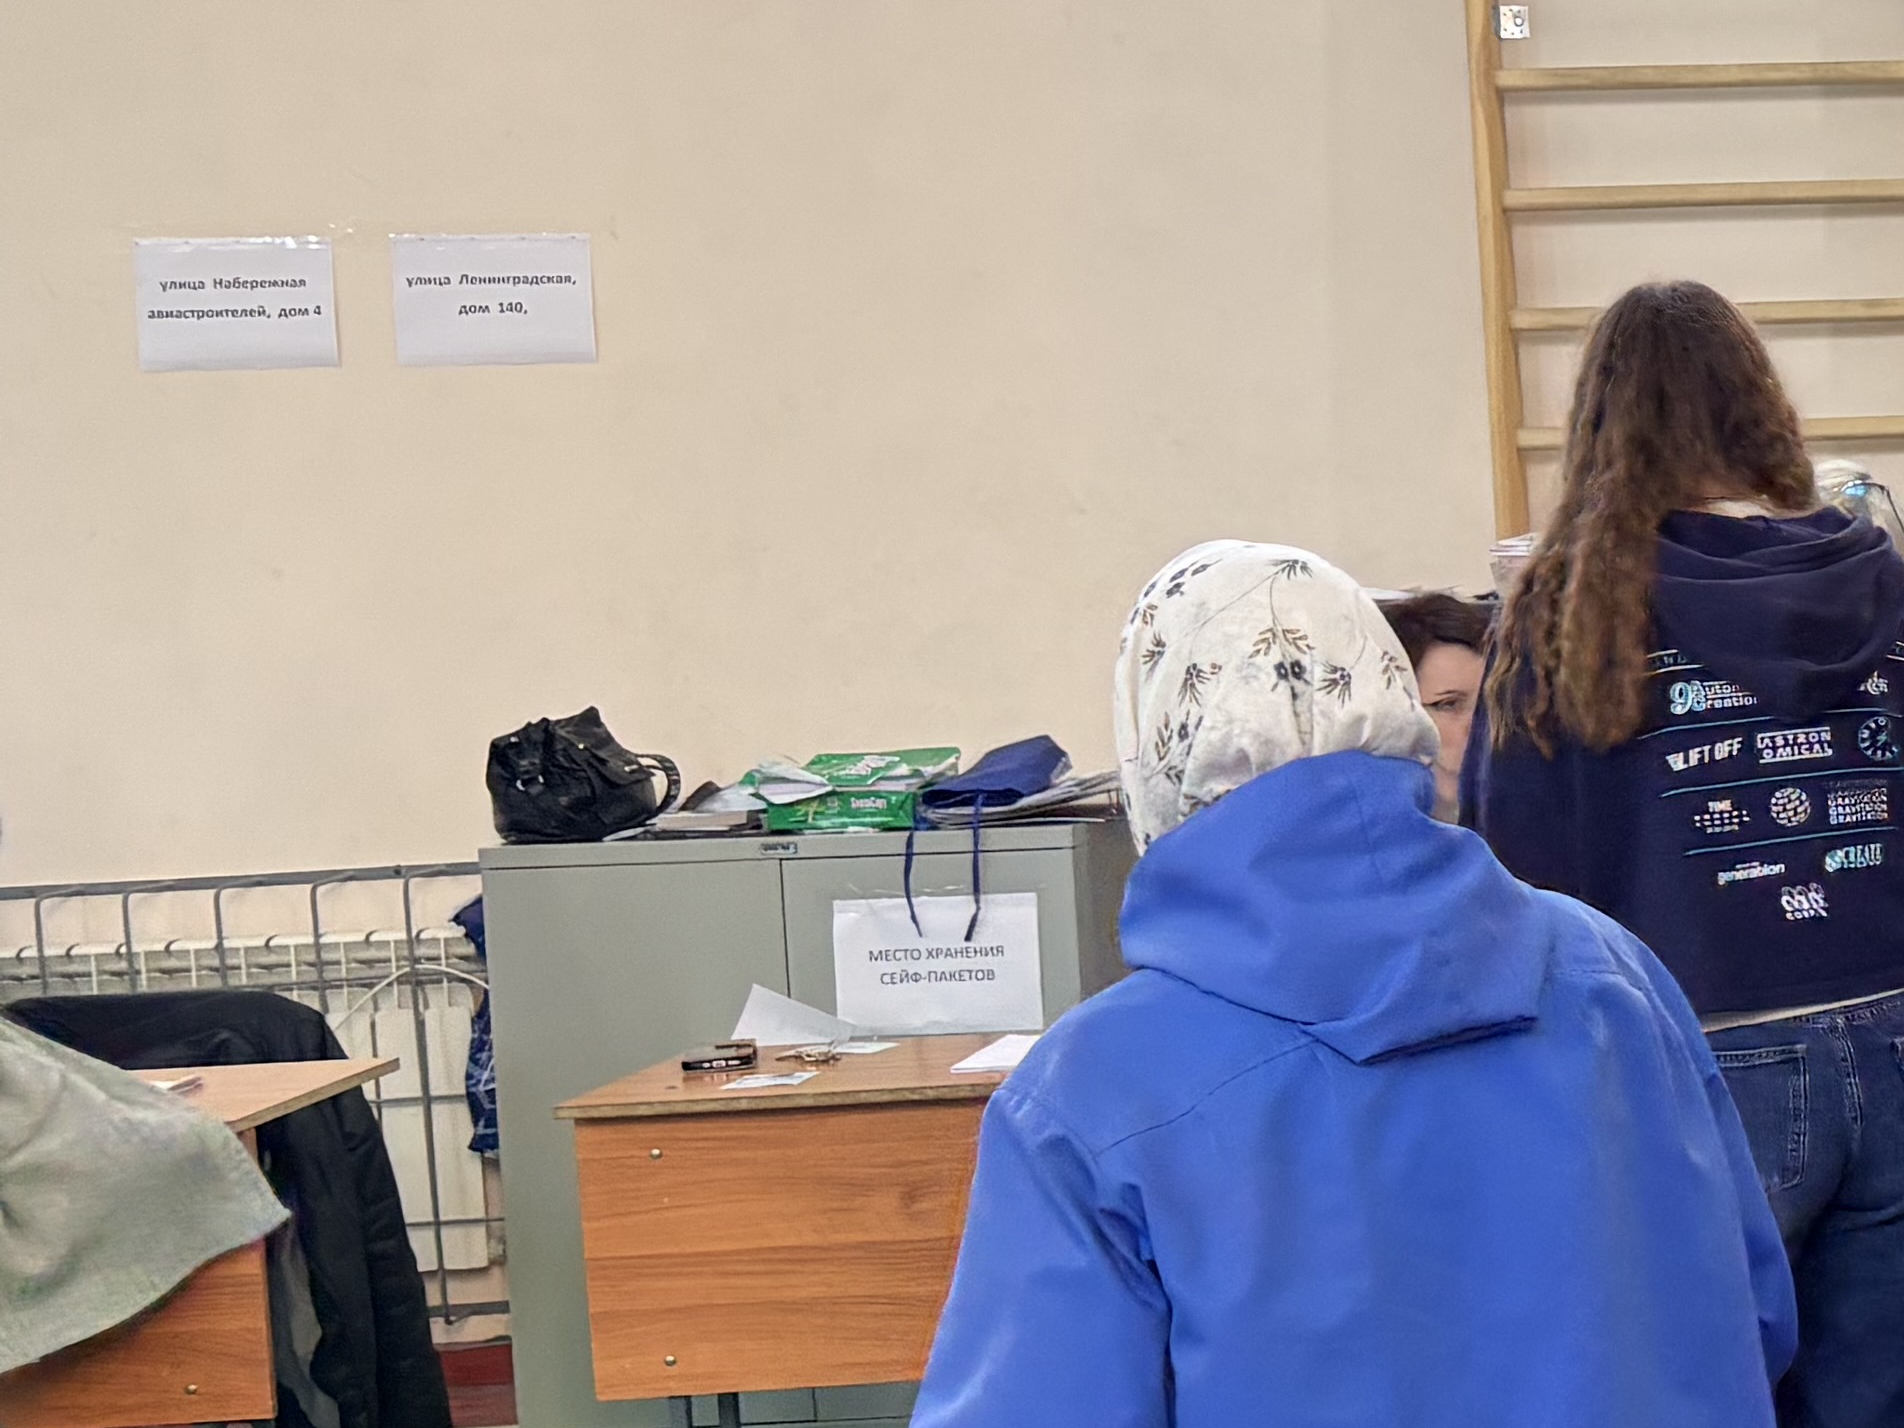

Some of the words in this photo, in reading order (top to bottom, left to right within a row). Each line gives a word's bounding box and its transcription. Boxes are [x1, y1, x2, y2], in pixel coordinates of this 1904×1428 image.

[159, 279, 206, 293] улица
[213, 277, 307, 291] Набережная
[406, 275, 451, 288] улица
[458, 273, 577, 287] Ленинградская,
[147, 305, 272, 321] авиастроителей,
[277, 307, 310, 319] дом
[313, 304, 322, 316] 4
[458, 304, 491, 316] дом
[498, 301, 528, 315] 140,
[1762, 731, 1832, 748] ASTRON
[1666, 745, 1712, 772] LIFT
[1714, 737, 1743, 761] OFF
[1762, 743, 1830, 760] OMICAL
[868, 947, 922, 962] МЕСТО
[925, 945, 1005, 961] ХРАНЕНИЯ
[879, 968, 996, 985] СЕЙФ-ПАКЕТОВ
